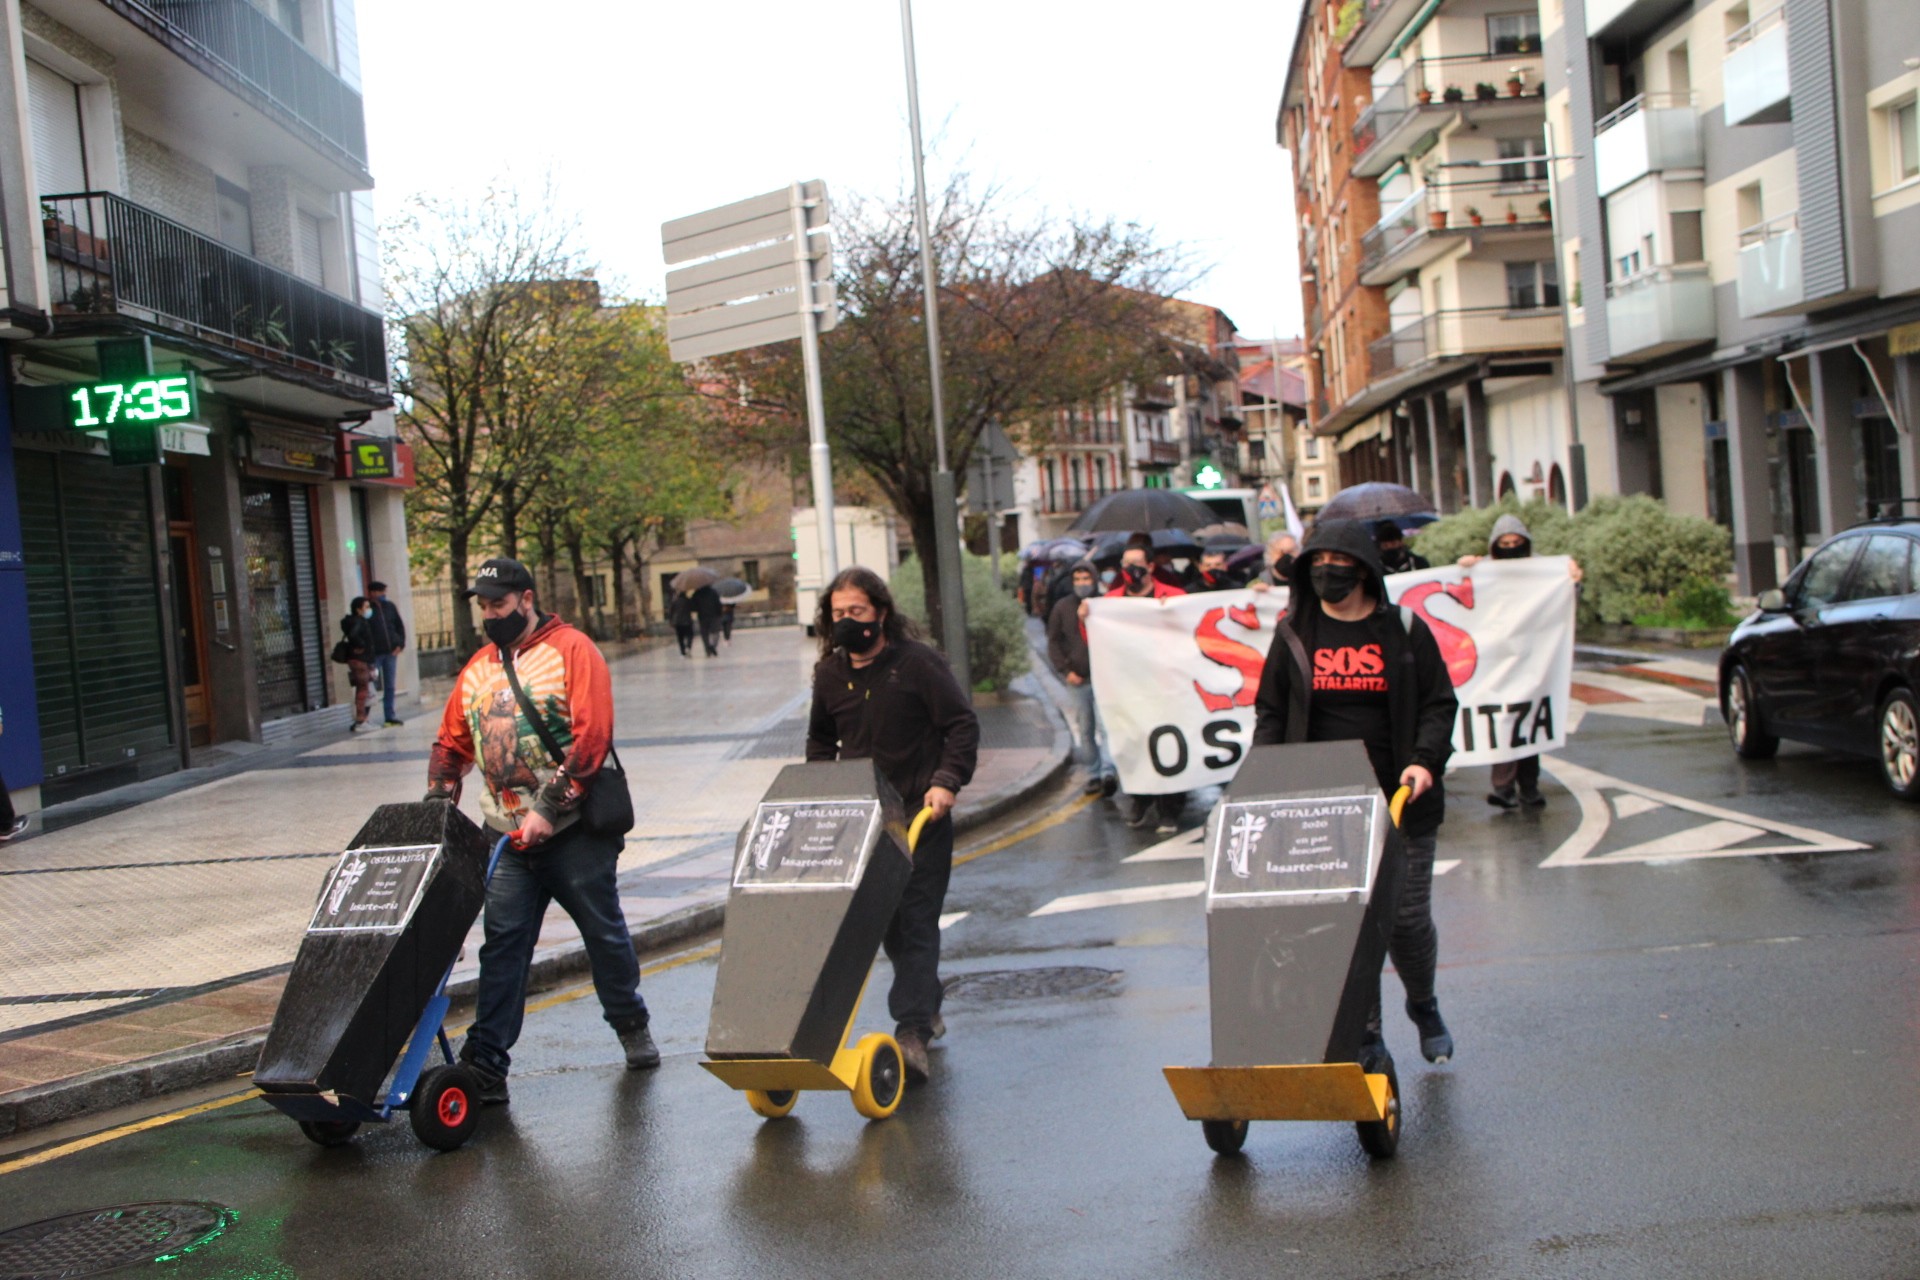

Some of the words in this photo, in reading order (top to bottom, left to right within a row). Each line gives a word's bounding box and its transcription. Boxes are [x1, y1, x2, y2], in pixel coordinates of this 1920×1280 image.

[72, 377, 191, 426] 17:35
[1313, 643, 1384, 676] SOS
[1312, 675, 1389, 692] STALARITZ
[794, 808, 865, 818] OSTALARITZA
[1270, 805, 1363, 818] OSTALARITZA
[1302, 820, 1328, 829] 2020
